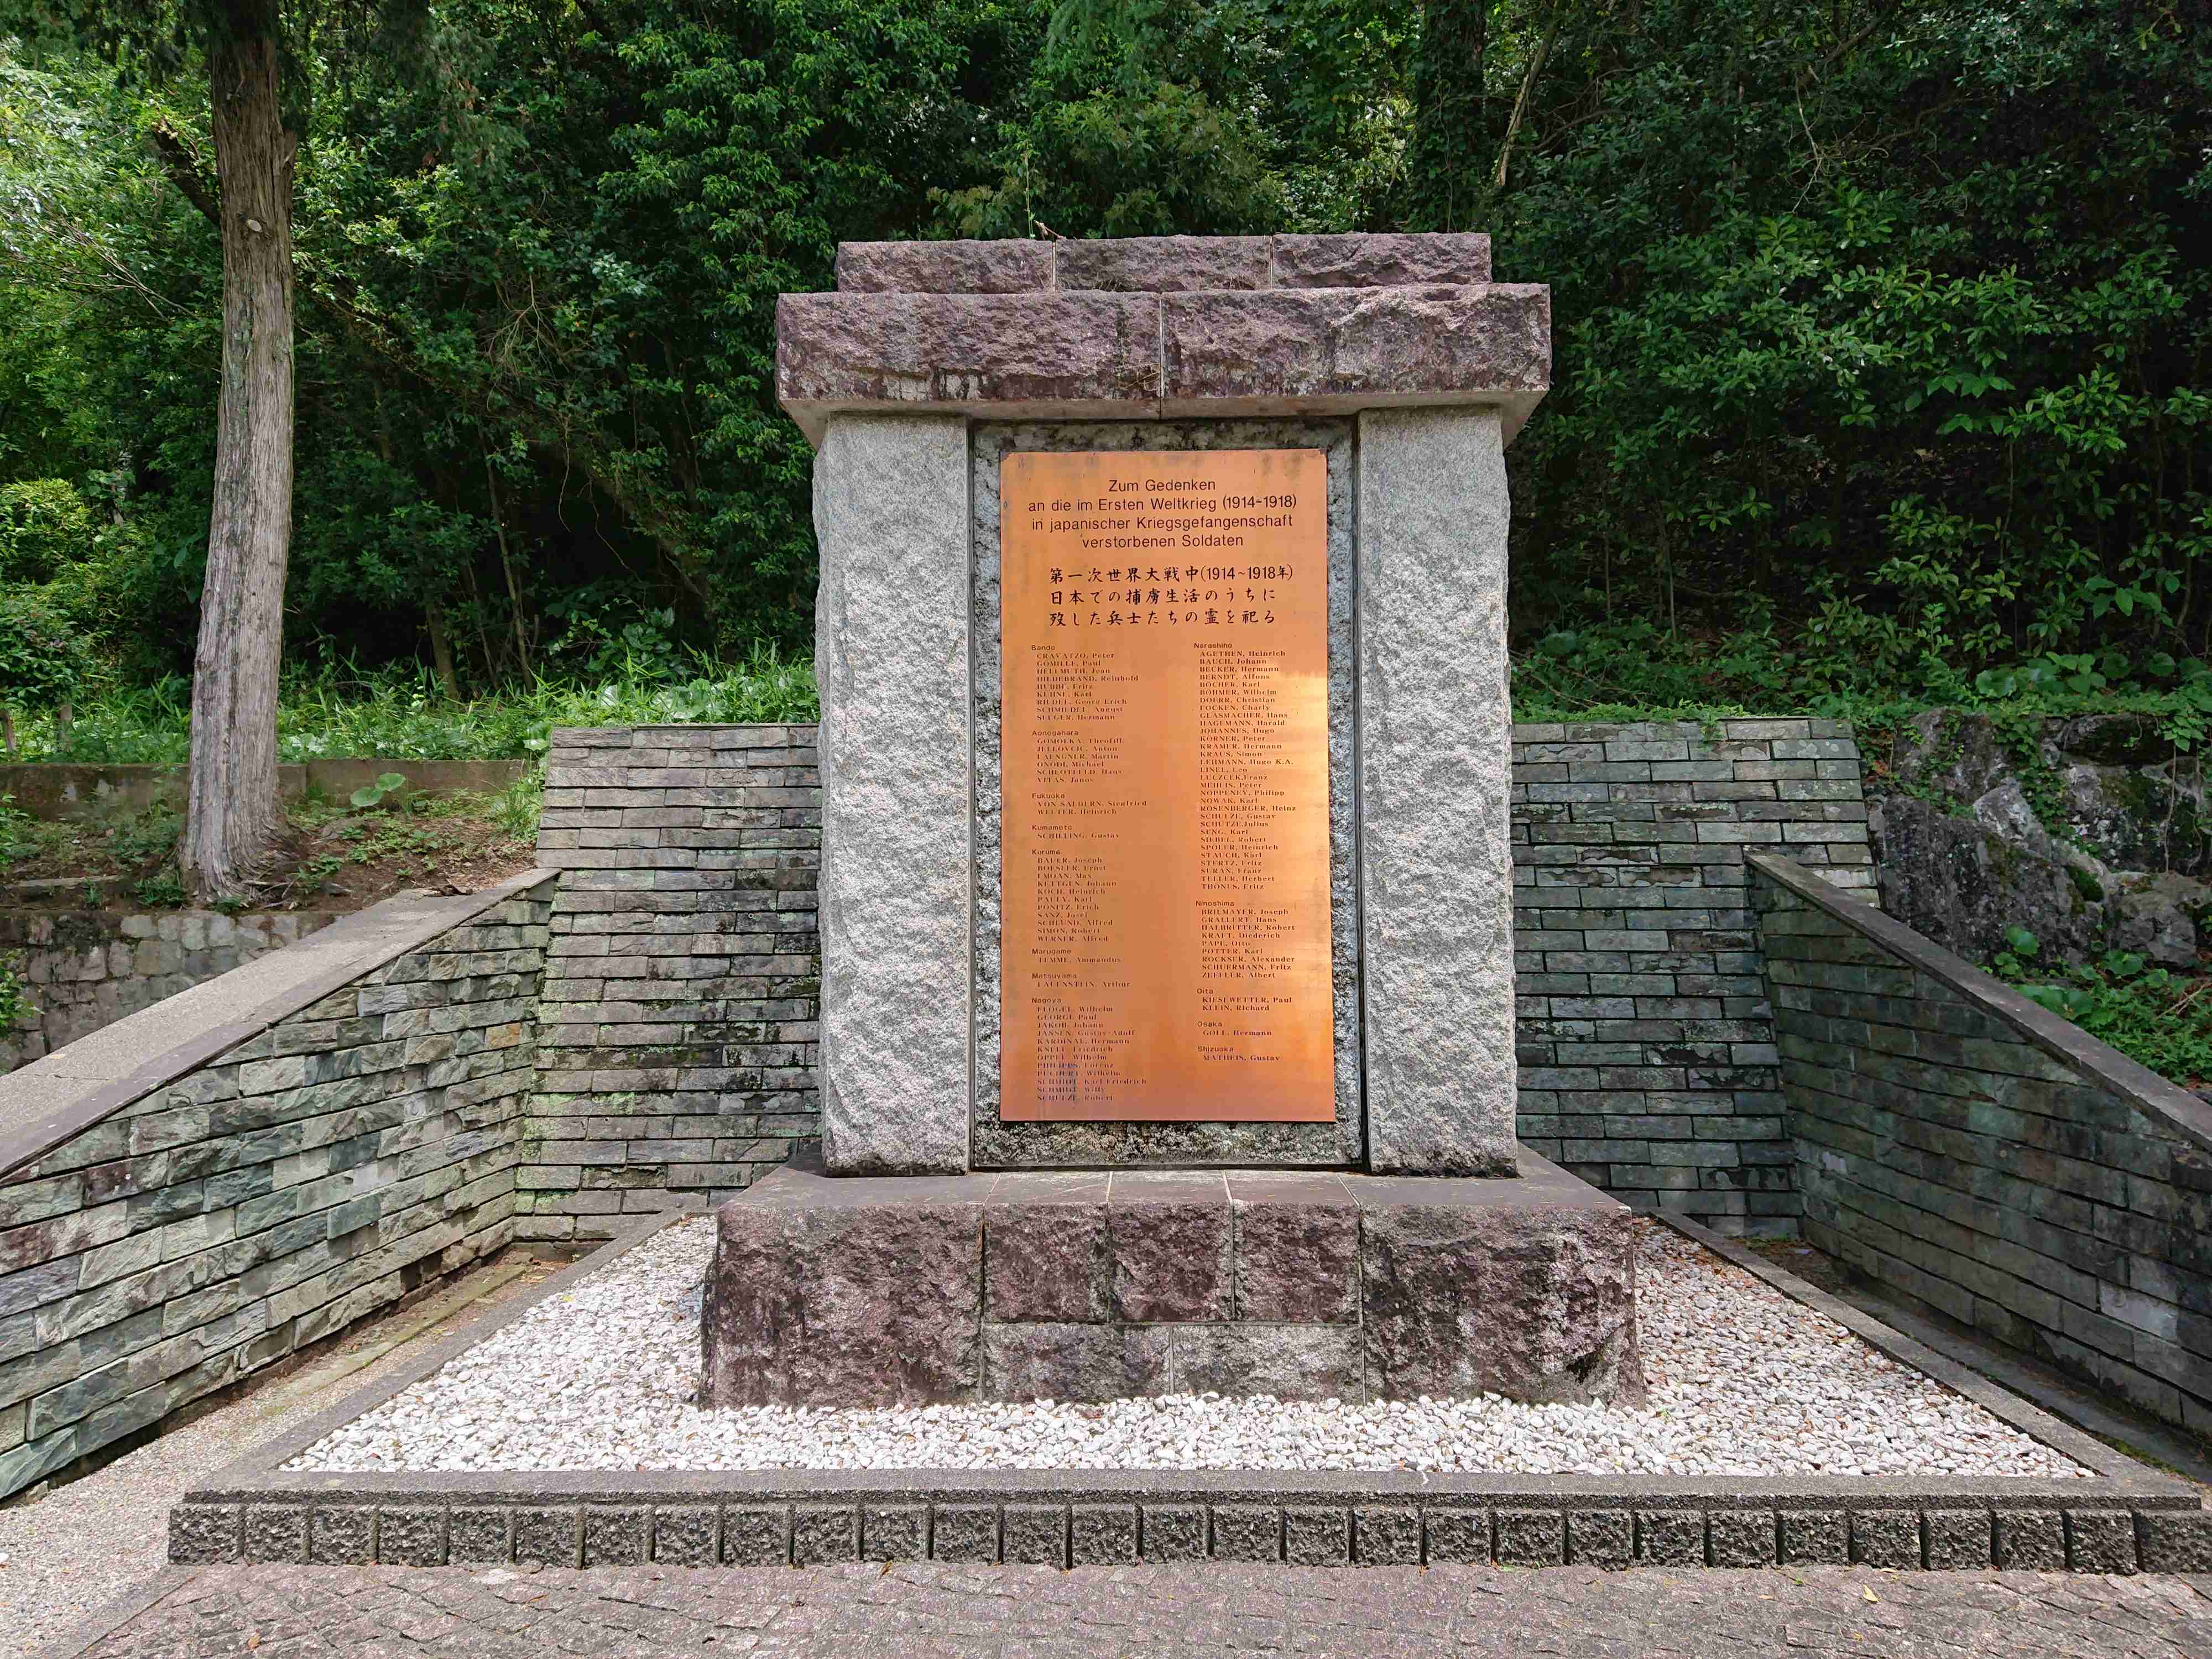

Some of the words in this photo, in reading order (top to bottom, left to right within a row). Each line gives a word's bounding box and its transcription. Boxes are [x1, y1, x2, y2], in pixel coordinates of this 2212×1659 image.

[1109, 480, 1138, 492] Zum
[1146, 479, 1215, 491] Gedenken
[1029, 503, 1044, 512] an
[1052, 499, 1071, 511] die
[1078, 499, 1092, 510] im
[1098, 499, 1143, 510] Ersten
[1151, 497, 1215, 512] Weltkrieg
[1223, 494, 1296, 509] (1914-1918)
[1032, 518, 1042, 530] in
[1050, 518, 1130, 533] japanischer
[1138, 514, 1292, 531] Kriegsgefangenschaft
[1082, 536, 1175, 548] verstorbenen
[1182, 534, 1243, 546] Soldaten
[1051, 588, 1275, 605] 日本での捕虜生活のうちに
